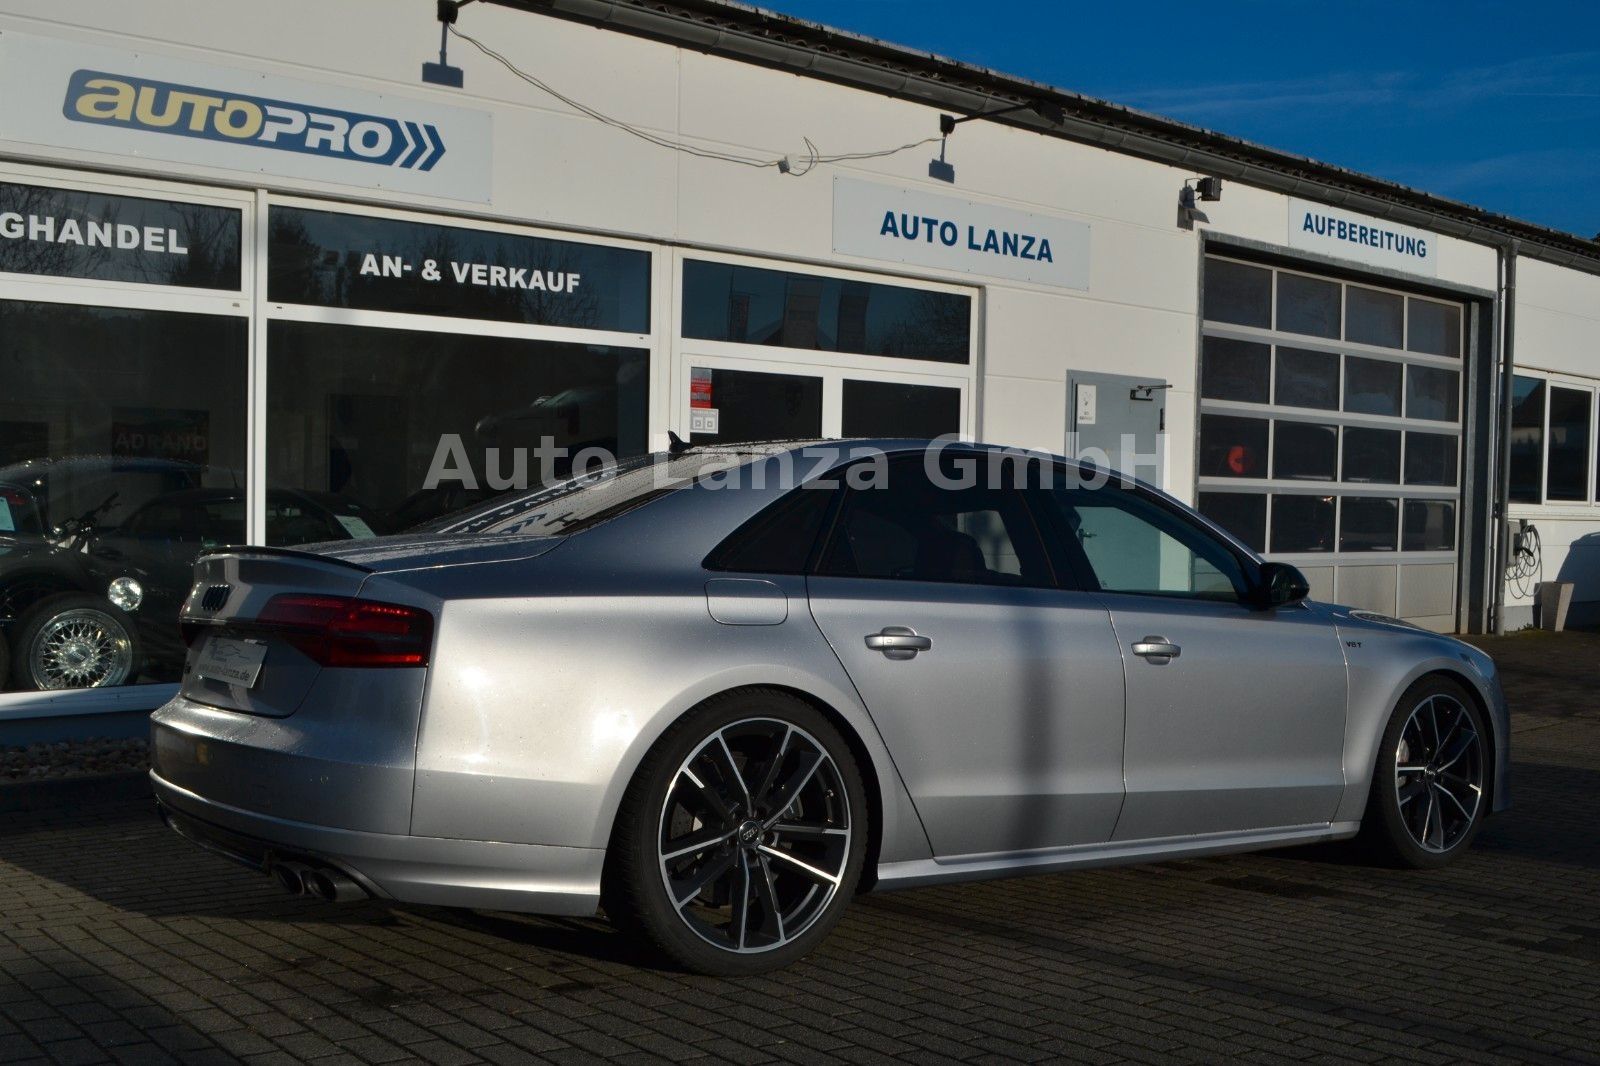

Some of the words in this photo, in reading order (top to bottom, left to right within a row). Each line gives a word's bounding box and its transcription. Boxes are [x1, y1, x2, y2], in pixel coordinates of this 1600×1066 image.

[0, 212, 188, 255] GHANDEL
[880, 211, 958, 246] AUTO
[968, 225, 1053, 263] LANZA
[1303, 212, 1427, 258] AUFBEREITUNG
[360, 253, 412, 279] AN-
[420, 259, 442, 283] &
[451, 261, 581, 293] VERKAUF
